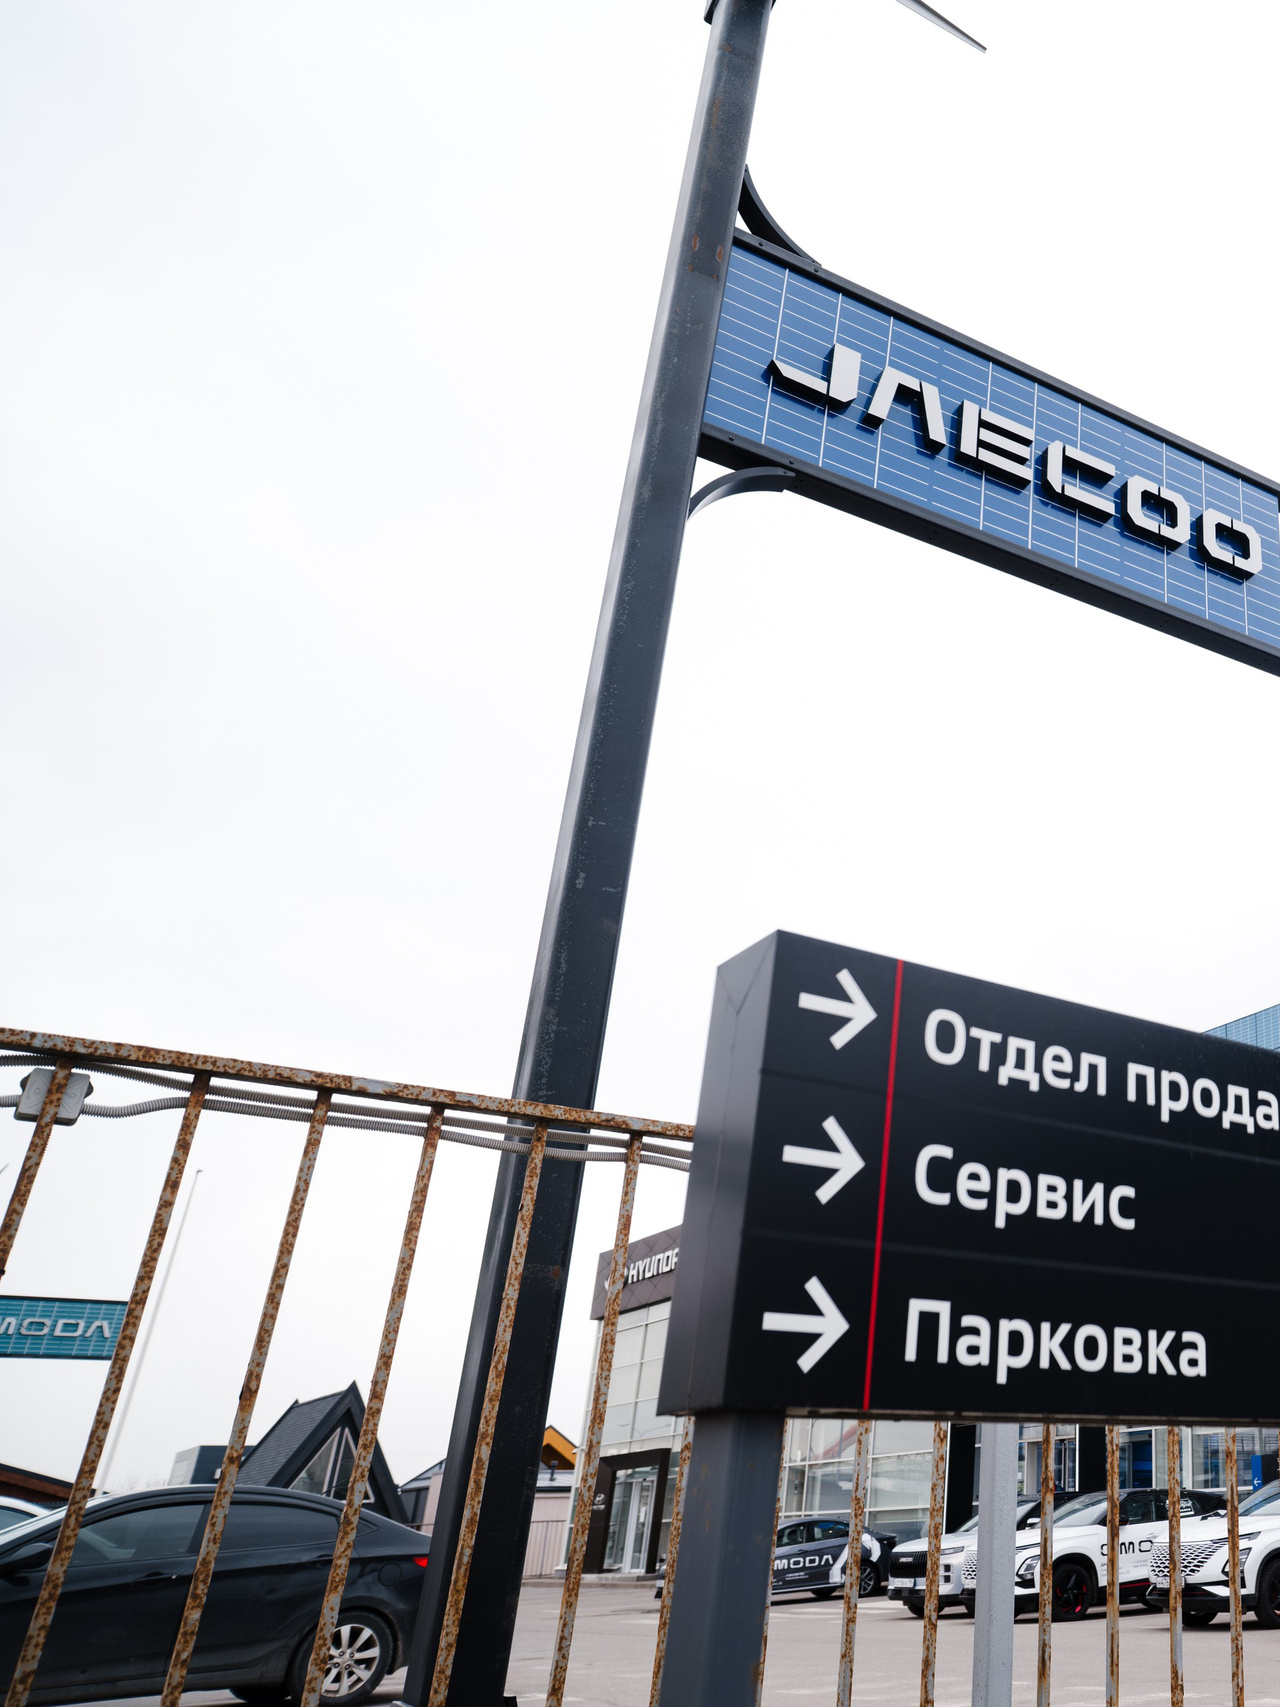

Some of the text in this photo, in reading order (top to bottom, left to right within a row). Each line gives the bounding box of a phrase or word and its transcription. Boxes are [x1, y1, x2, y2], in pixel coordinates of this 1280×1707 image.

[768, 342, 1263, 580] JAECOO
[923, 1007, 1107, 1096] Отдел
[914, 1143, 1136, 1230] Сервис
[628, 1247, 680, 1284] HYUNDA
[0, 1317, 110, 1338] MODA
[904, 1297, 1208, 1385] Парковка
[774, 1554, 834, 1570] MODA
